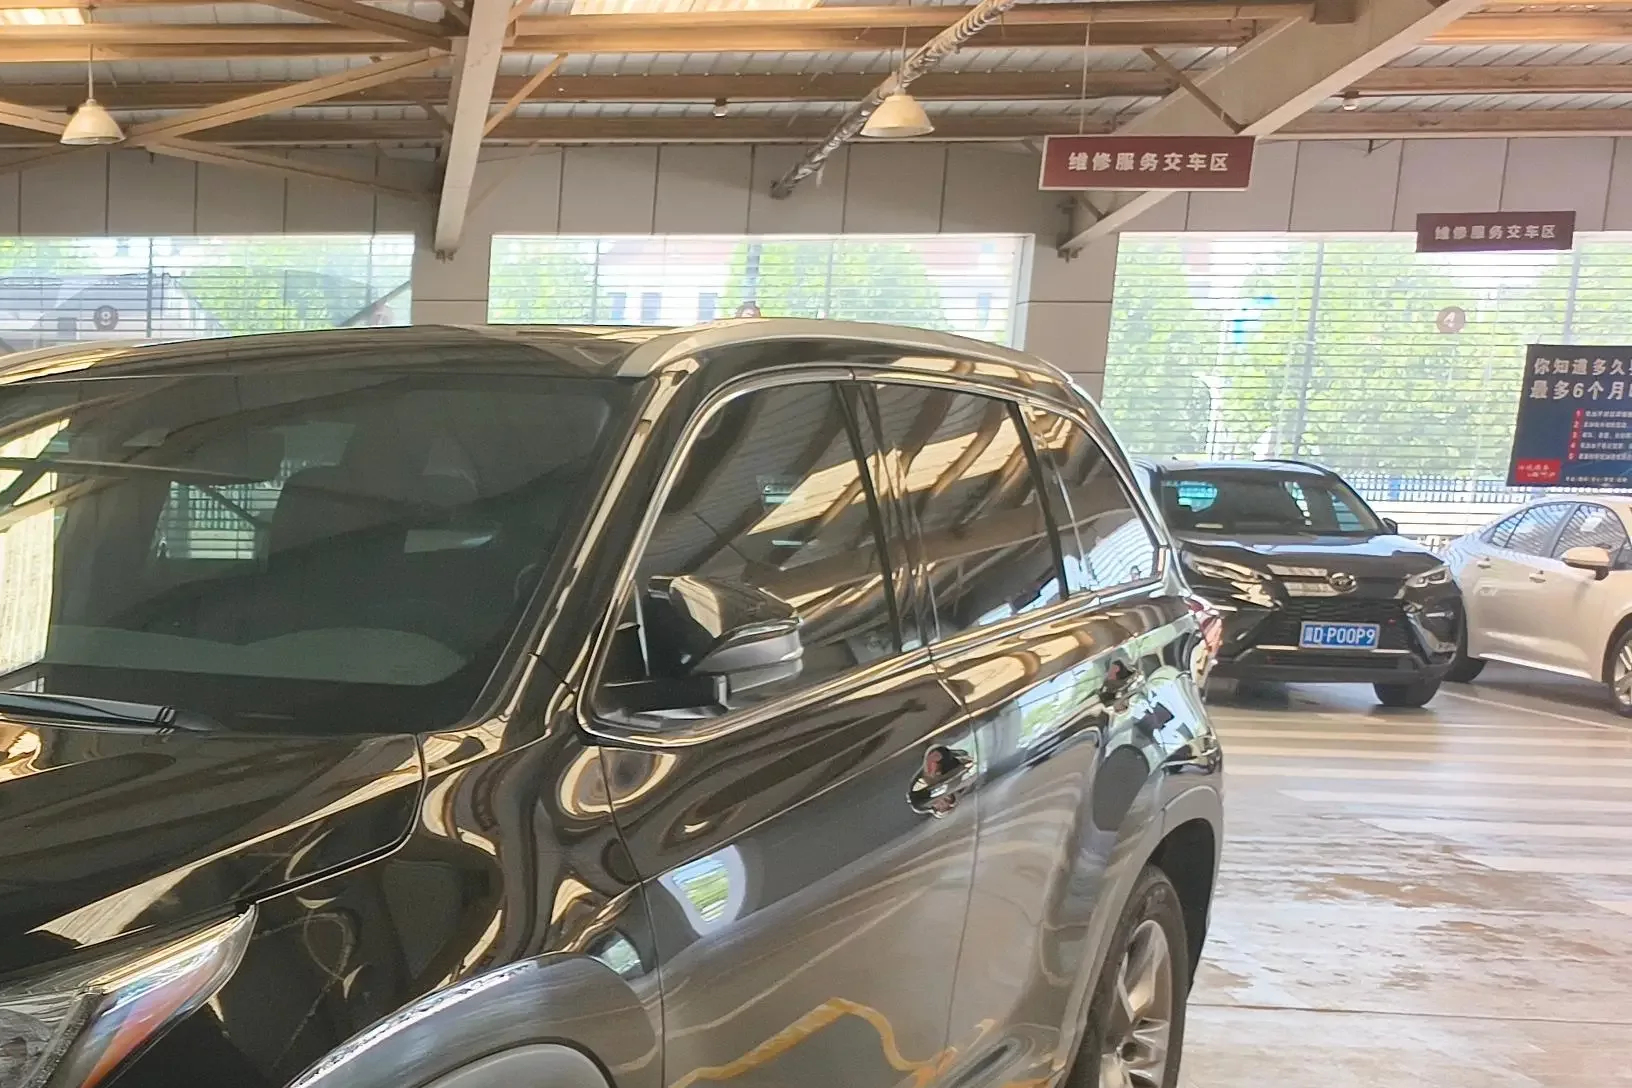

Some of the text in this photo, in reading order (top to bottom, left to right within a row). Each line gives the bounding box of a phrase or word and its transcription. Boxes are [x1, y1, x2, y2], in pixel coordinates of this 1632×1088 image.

[1068, 151, 1229, 172] 维修服务交车区
[1534, 357, 1632, 377] 你知道多久
[1530, 379, 1632, 401] 最多6个月
